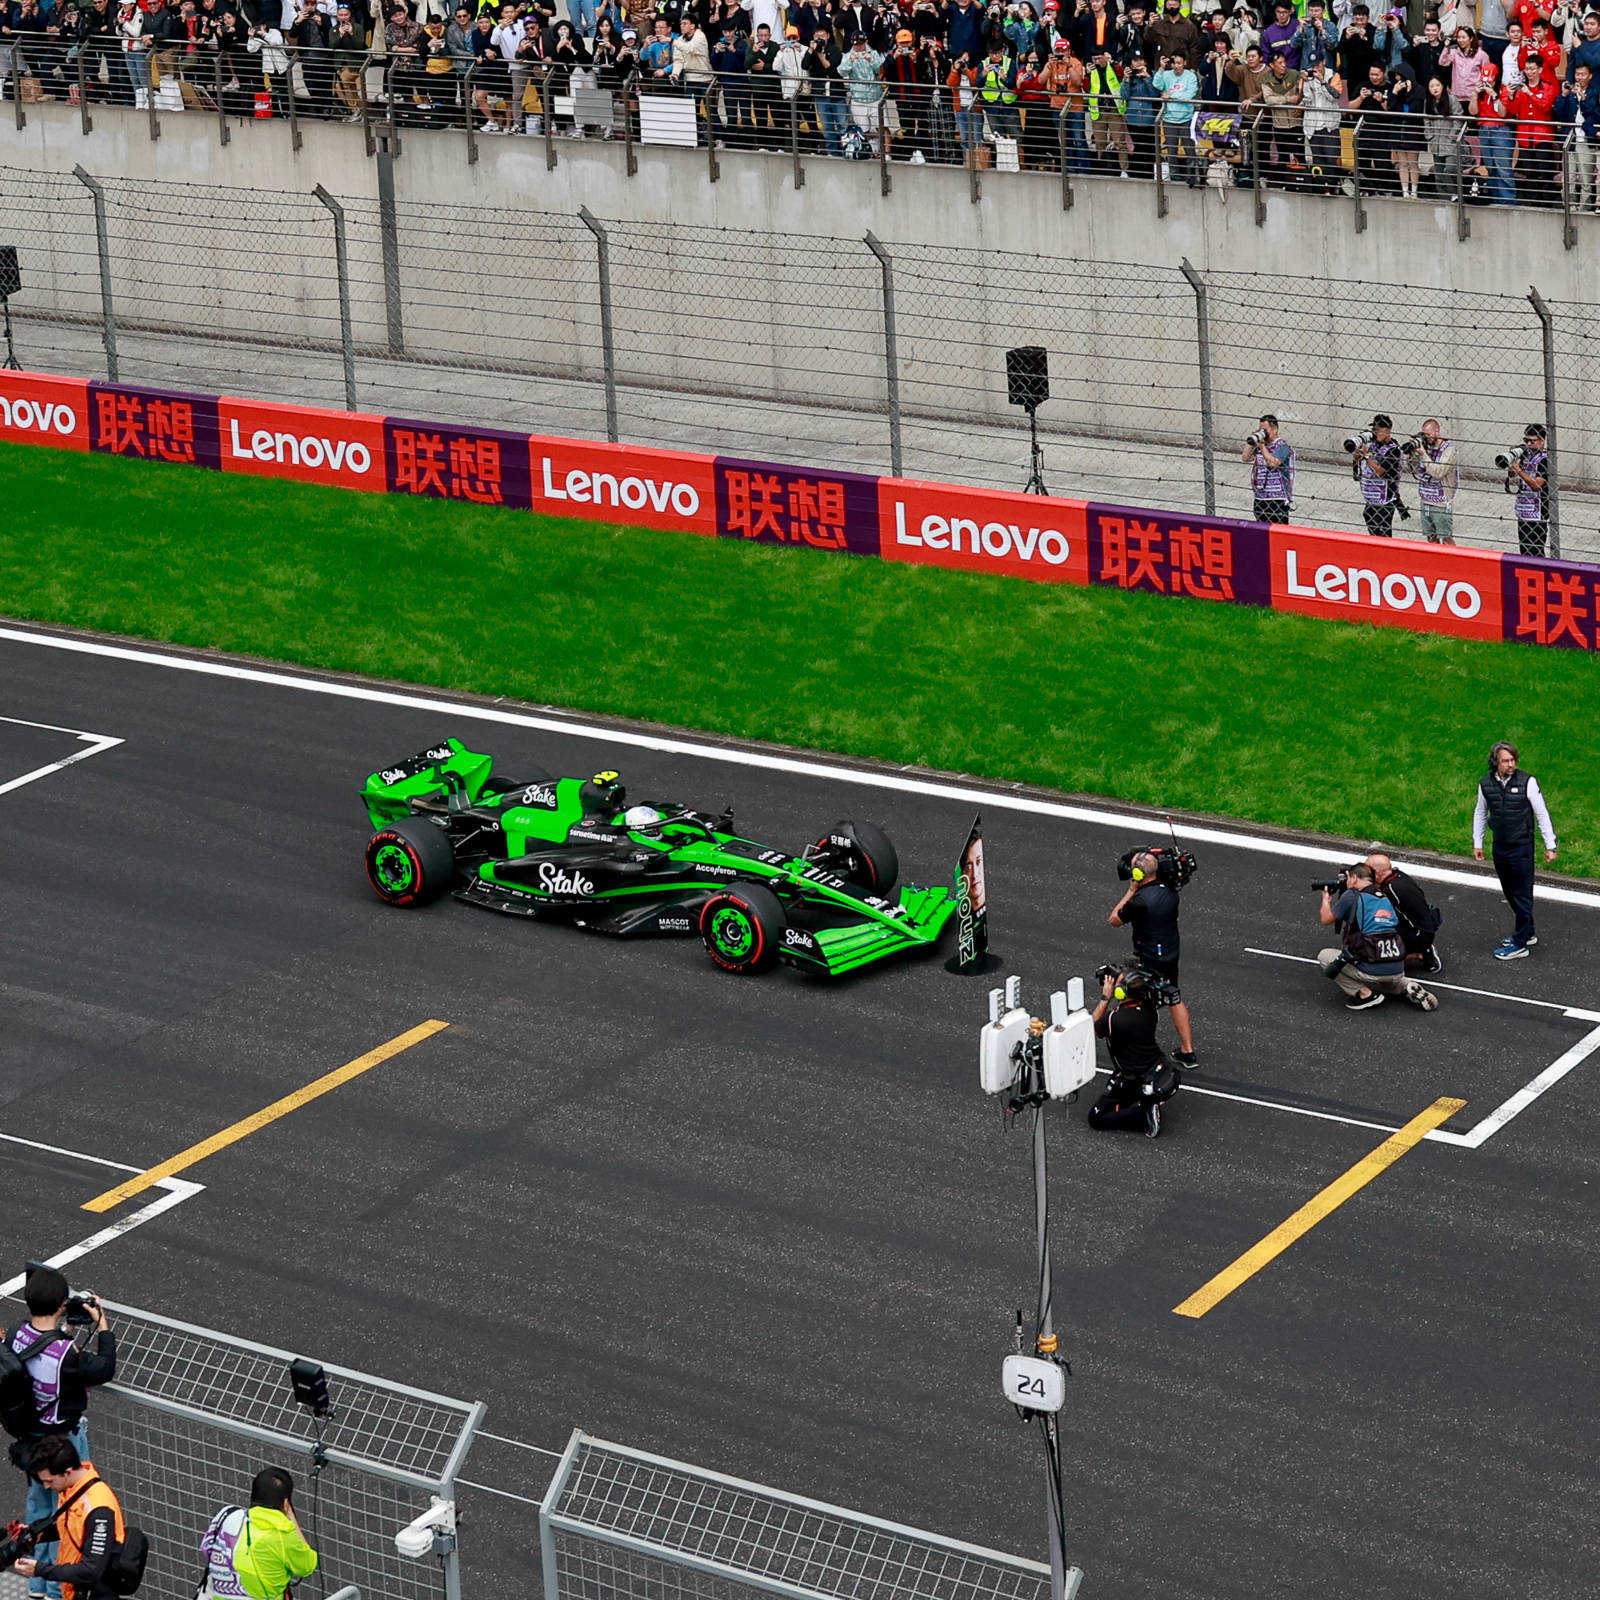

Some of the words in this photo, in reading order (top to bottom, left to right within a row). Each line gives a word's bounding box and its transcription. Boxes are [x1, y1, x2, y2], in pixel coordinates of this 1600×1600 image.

[95, 391, 195, 463] 联想
[230, 419, 371, 475] Lenovo
[392, 429, 503, 503] 联想
[542, 457, 700, 517] Lenovo
[724, 470, 849, 549] 联想
[895, 501, 1070, 565] Lenovo
[1098, 515, 1235, 600] 联想
[1285, 549, 1482, 619] Lenovo
[522, 784, 557, 807] Stake
[539, 862, 594, 895] Stake
[658, 918, 689, 926] MASCOT
[785, 928, 813, 948] Stake
[1016, 1373, 1046, 1398] 24
